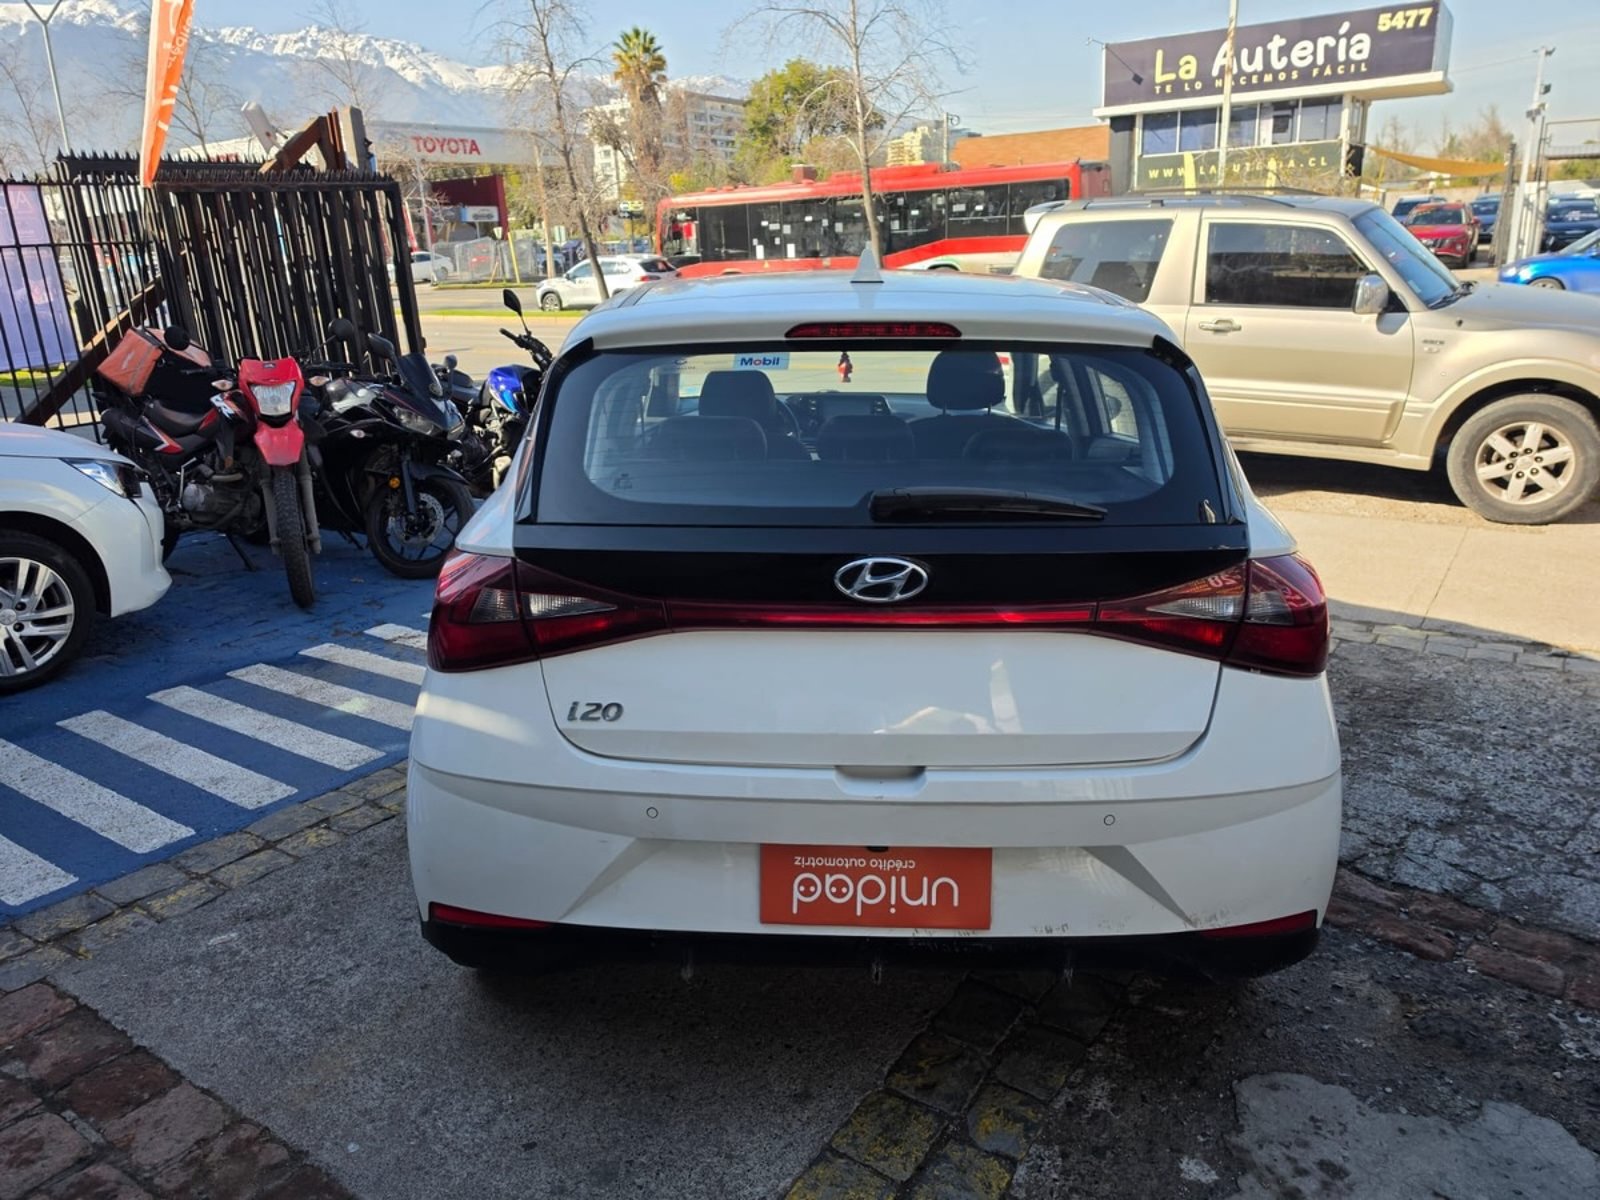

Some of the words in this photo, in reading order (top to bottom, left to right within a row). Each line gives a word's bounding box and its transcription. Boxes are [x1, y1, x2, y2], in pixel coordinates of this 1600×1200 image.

[1377, 7, 1433, 31] 5477
[1155, 49, 1197, 83] La
[1211, 21, 1371, 77] Autería
[1155, 84, 1172, 94] TE
[1185, 81, 1202, 91] LO
[1215, 70, 1299, 88] HCEMOS
[1312, 63, 1367, 77] FÁCIL
[412, 135, 481, 155] TOYOTA
[740, 357, 780, 367] Mobil
[567, 701, 624, 722] i20
[794, 855, 867, 868] automotriz
[870, 857, 916, 871] crédito
[792, 872, 959, 916] unidad
